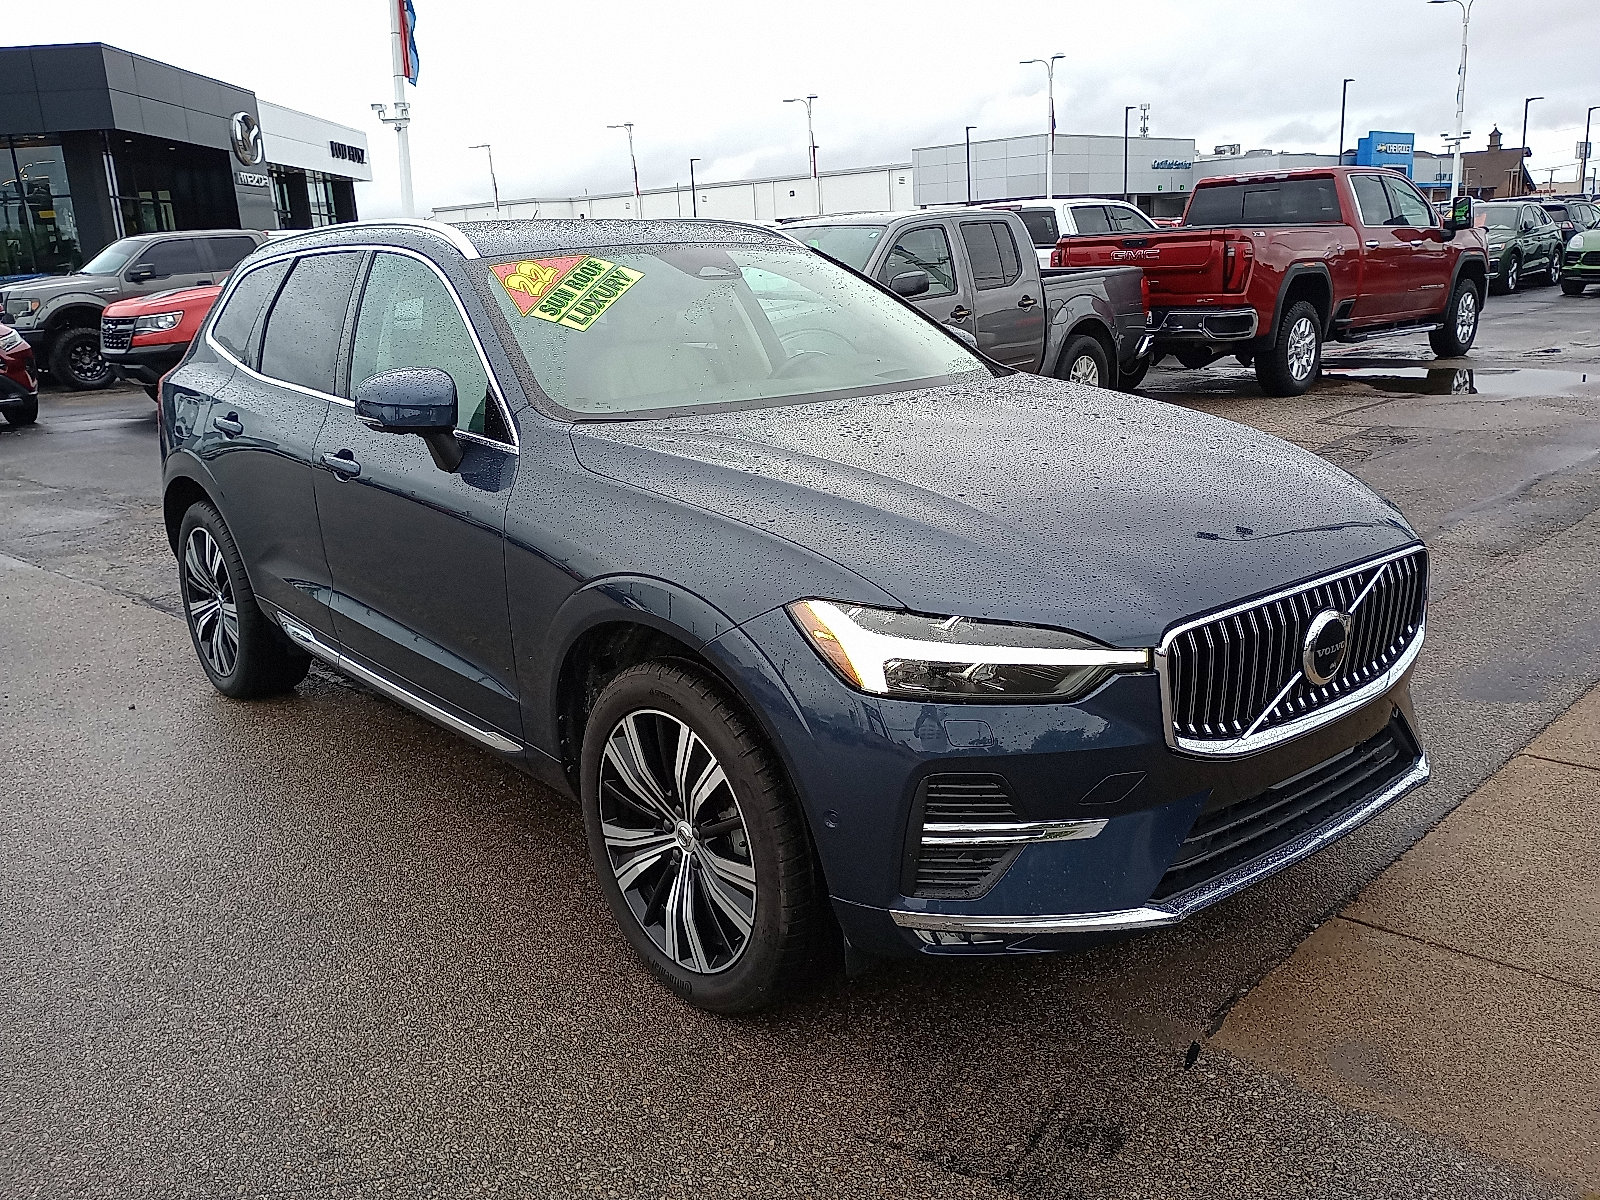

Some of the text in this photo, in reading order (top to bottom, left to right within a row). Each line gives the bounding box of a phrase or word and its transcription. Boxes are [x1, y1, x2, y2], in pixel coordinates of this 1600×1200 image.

[1110, 249, 1160, 261] GMC
[504, 260, 560, 297] 22
[539, 259, 606, 316] SUN ROOF
[566, 269, 634, 326] LUXURY
[1316, 640, 1346, 658] VOLVO
